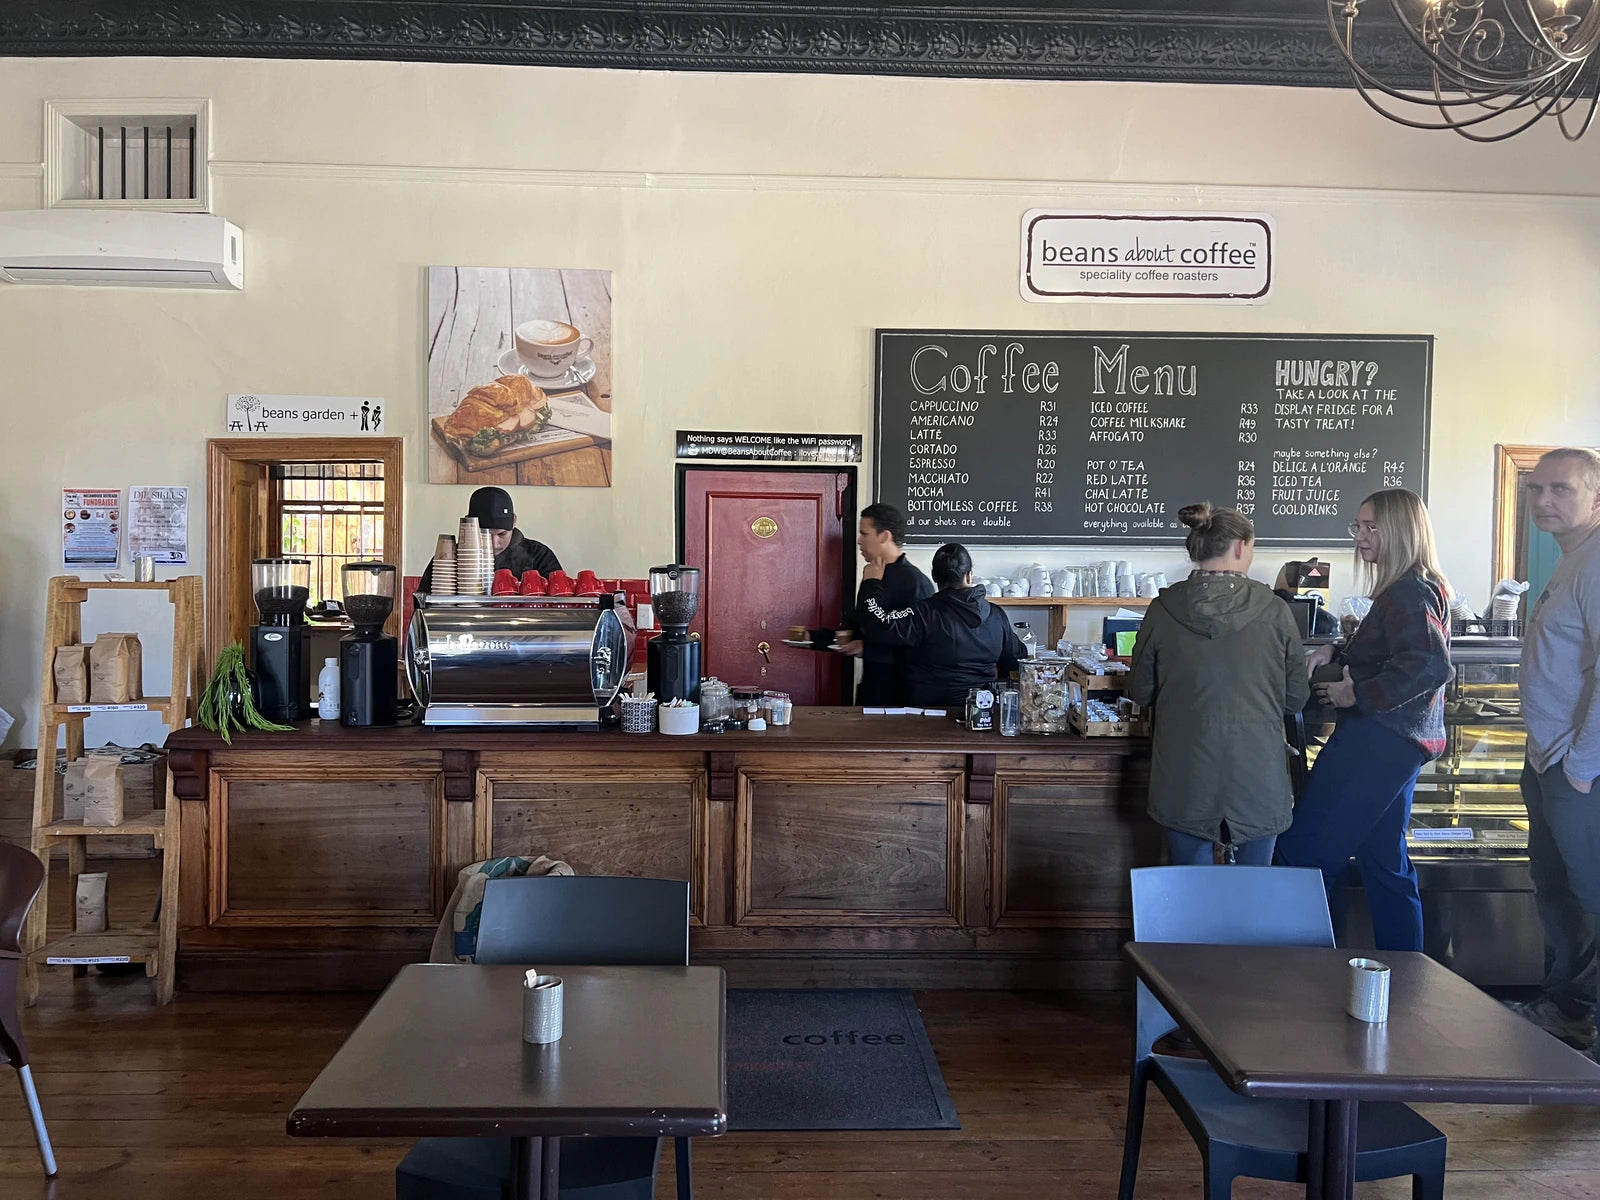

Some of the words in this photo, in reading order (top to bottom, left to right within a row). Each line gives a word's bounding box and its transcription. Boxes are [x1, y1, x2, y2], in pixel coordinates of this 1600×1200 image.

[1042, 240, 1118, 262] beans
[1125, 236, 1175, 263] about
[1080, 269, 1131, 282] speciality
[1135, 269, 1169, 281] coffee
[1172, 270, 1218, 282] roasters
[910, 343, 1059, 395] Coffee
[1093, 344, 1196, 396] Menu
[1276, 360, 1378, 386] HUNGRY?
[1276, 389, 1304, 400] TAKE
[1307, 390, 1315, 399] A
[1319, 389, 1349, 399] LOOK
[1352, 389, 1368, 400] AT
[1375, 390, 1397, 400] THE
[910, 401, 979, 412] CAPPUCCINO
[1041, 401, 1056, 411] R31
[1091, 402, 1112, 413] ICED
[1116, 402, 1148, 413] COFFEE
[1241, 403, 1258, 414] R33
[1275, 403, 1313, 415] DISPLAY
[1317, 404, 1357, 415] FRIDGE
[1362, 404, 1382, 415] FOR
[1386, 404, 1393, 415] A
[262, 407, 298, 419] beans
[302, 408, 345, 421] garden
[910, 415, 974, 426] AMERICANO
[1040, 416, 1058, 426] R24
[1091, 417, 1125, 428] COFFEE
[1130, 417, 1186, 428] MILKSHAKE
[1239, 418, 1256, 429] R49
[1275, 418, 1310, 429] TASTY
[1315, 419, 1354, 430] TREAT!
[687, 434, 715, 445] Nothing
[717, 436, 733, 445] says
[734, 435, 772, 444] WELCOME
[773, 436, 786, 444] like
[787, 437, 800, 445] the
[818, 437, 852, 446] password
[1039, 430, 1056, 441] R33
[1089, 431, 1144, 442] AFFOGATO
[1239, 432, 1257, 443] R30
[910, 444, 957, 455] CORTADO
[1038, 444, 1056, 455] R26
[1273, 448, 1301, 461] maybe
[1305, 449, 1350, 462] something
[1354, 448, 1377, 458] else?
[909, 458, 956, 469] ESPRESSO
[1037, 459, 1055, 469] R20
[1087, 460, 1105, 470] POT
[1120, 461, 1144, 471] TEA
[1239, 461, 1255, 471] R24
[1273, 460, 1307, 472] DELICE
[1311, 462, 1317, 472] A
[1321, 462, 1366, 472] L'ORANGE
[1384, 461, 1404, 473] R45
[909, 473, 969, 484] MACCHIATO
[1036, 473, 1053, 483] R22
[1087, 474, 1107, 485] RED
[1238, 475, 1255, 486] R36
[1273, 476, 1297, 487] ICED
[1301, 476, 1321, 487] TEA
[1384, 476, 1403, 487] R36
[908, 487, 943, 497] MOCHA
[1035, 487, 1050, 498] R41
[1085, 489, 1109, 499] CHAI
[1237, 489, 1255, 500] R39
[1272, 489, 1303, 501] FRUIT
[1306, 489, 1340, 501] JUICE
[83, 498, 118, 506] FUNDRAISER
[908, 500, 973, 511] BOTTOMLESS
[978, 501, 1018, 512] COFFEE
[1035, 501, 1052, 512] R38
[1085, 502, 1104, 512] HOT
[1107, 503, 1165, 513] CHOCOLATE
[1236, 503, 1255, 515] R37
[935, 516, 956, 526] shots
[983, 516, 1010, 526] double
[1084, 519, 1127, 533] everything
[1133, 518, 1164, 528] available
[782, 1029, 906, 1046] coffee
